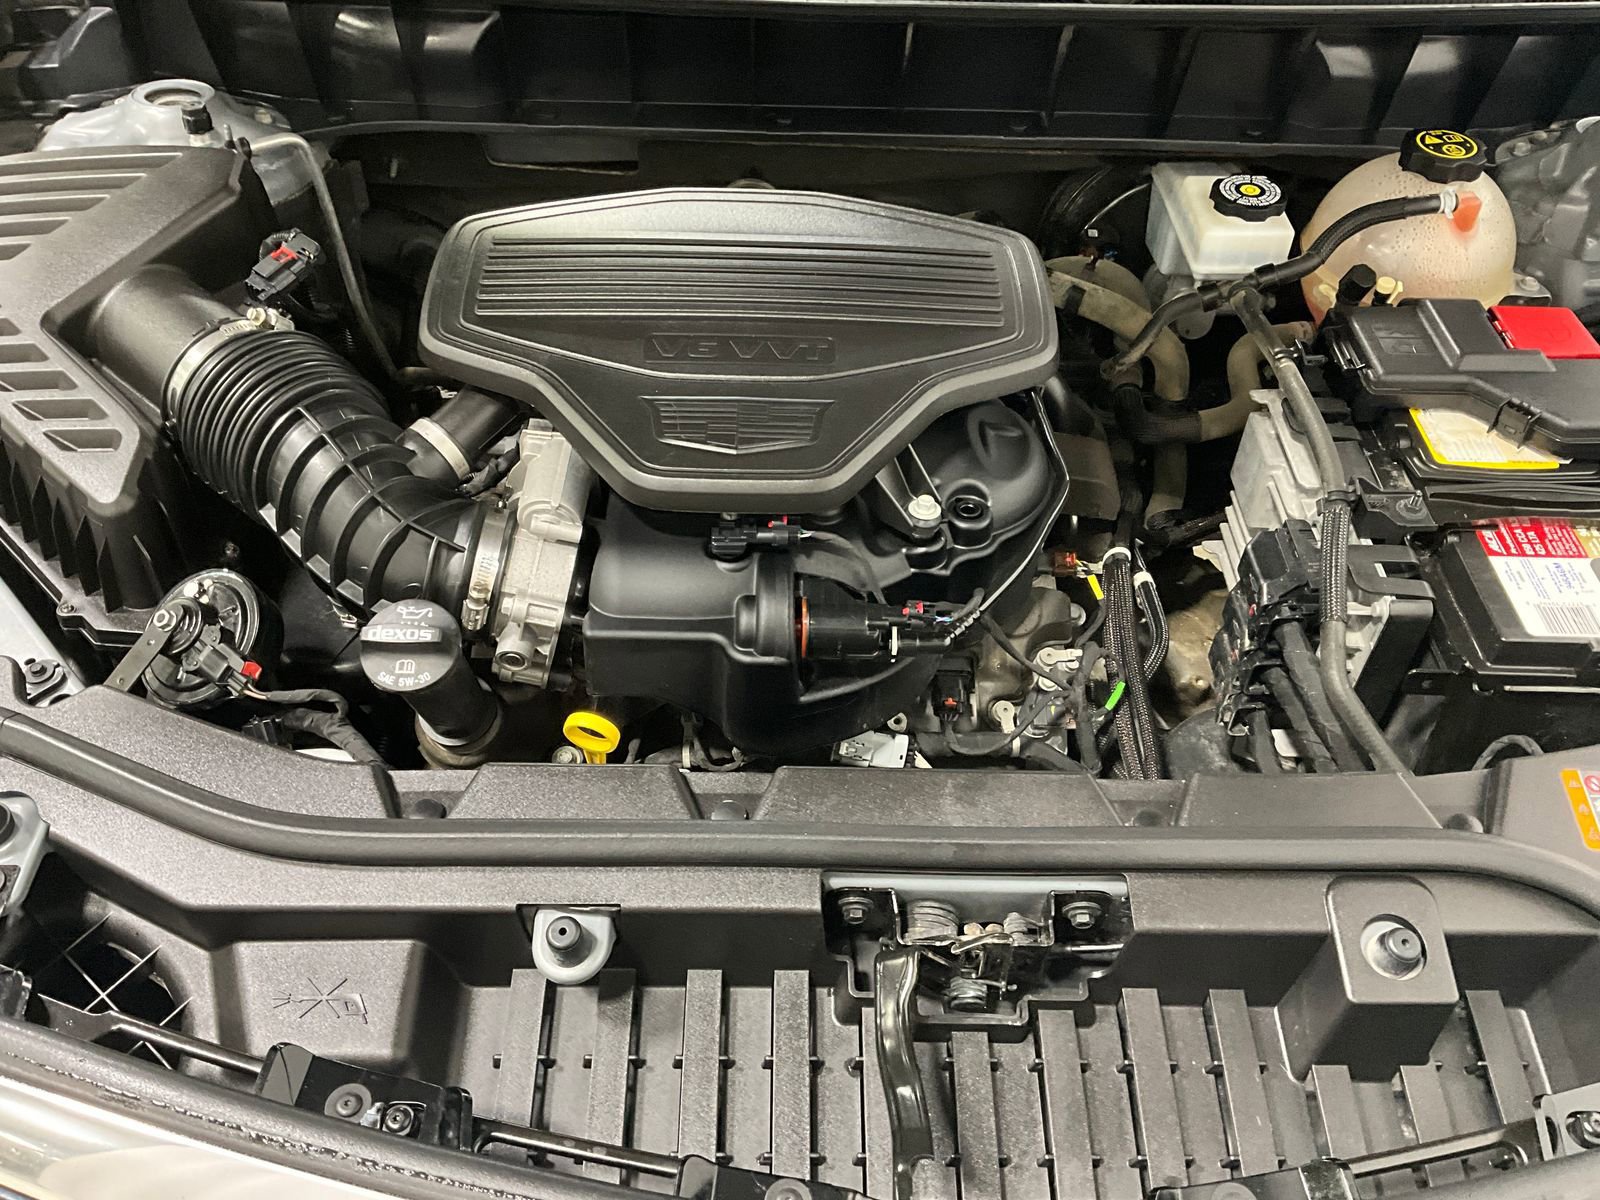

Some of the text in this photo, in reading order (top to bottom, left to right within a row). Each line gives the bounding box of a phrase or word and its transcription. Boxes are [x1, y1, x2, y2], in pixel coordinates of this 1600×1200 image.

[652, 337, 829, 361] V6 VVT
[368, 625, 433, 641] dexos
[378, 672, 431, 687] SAE 5W-30
